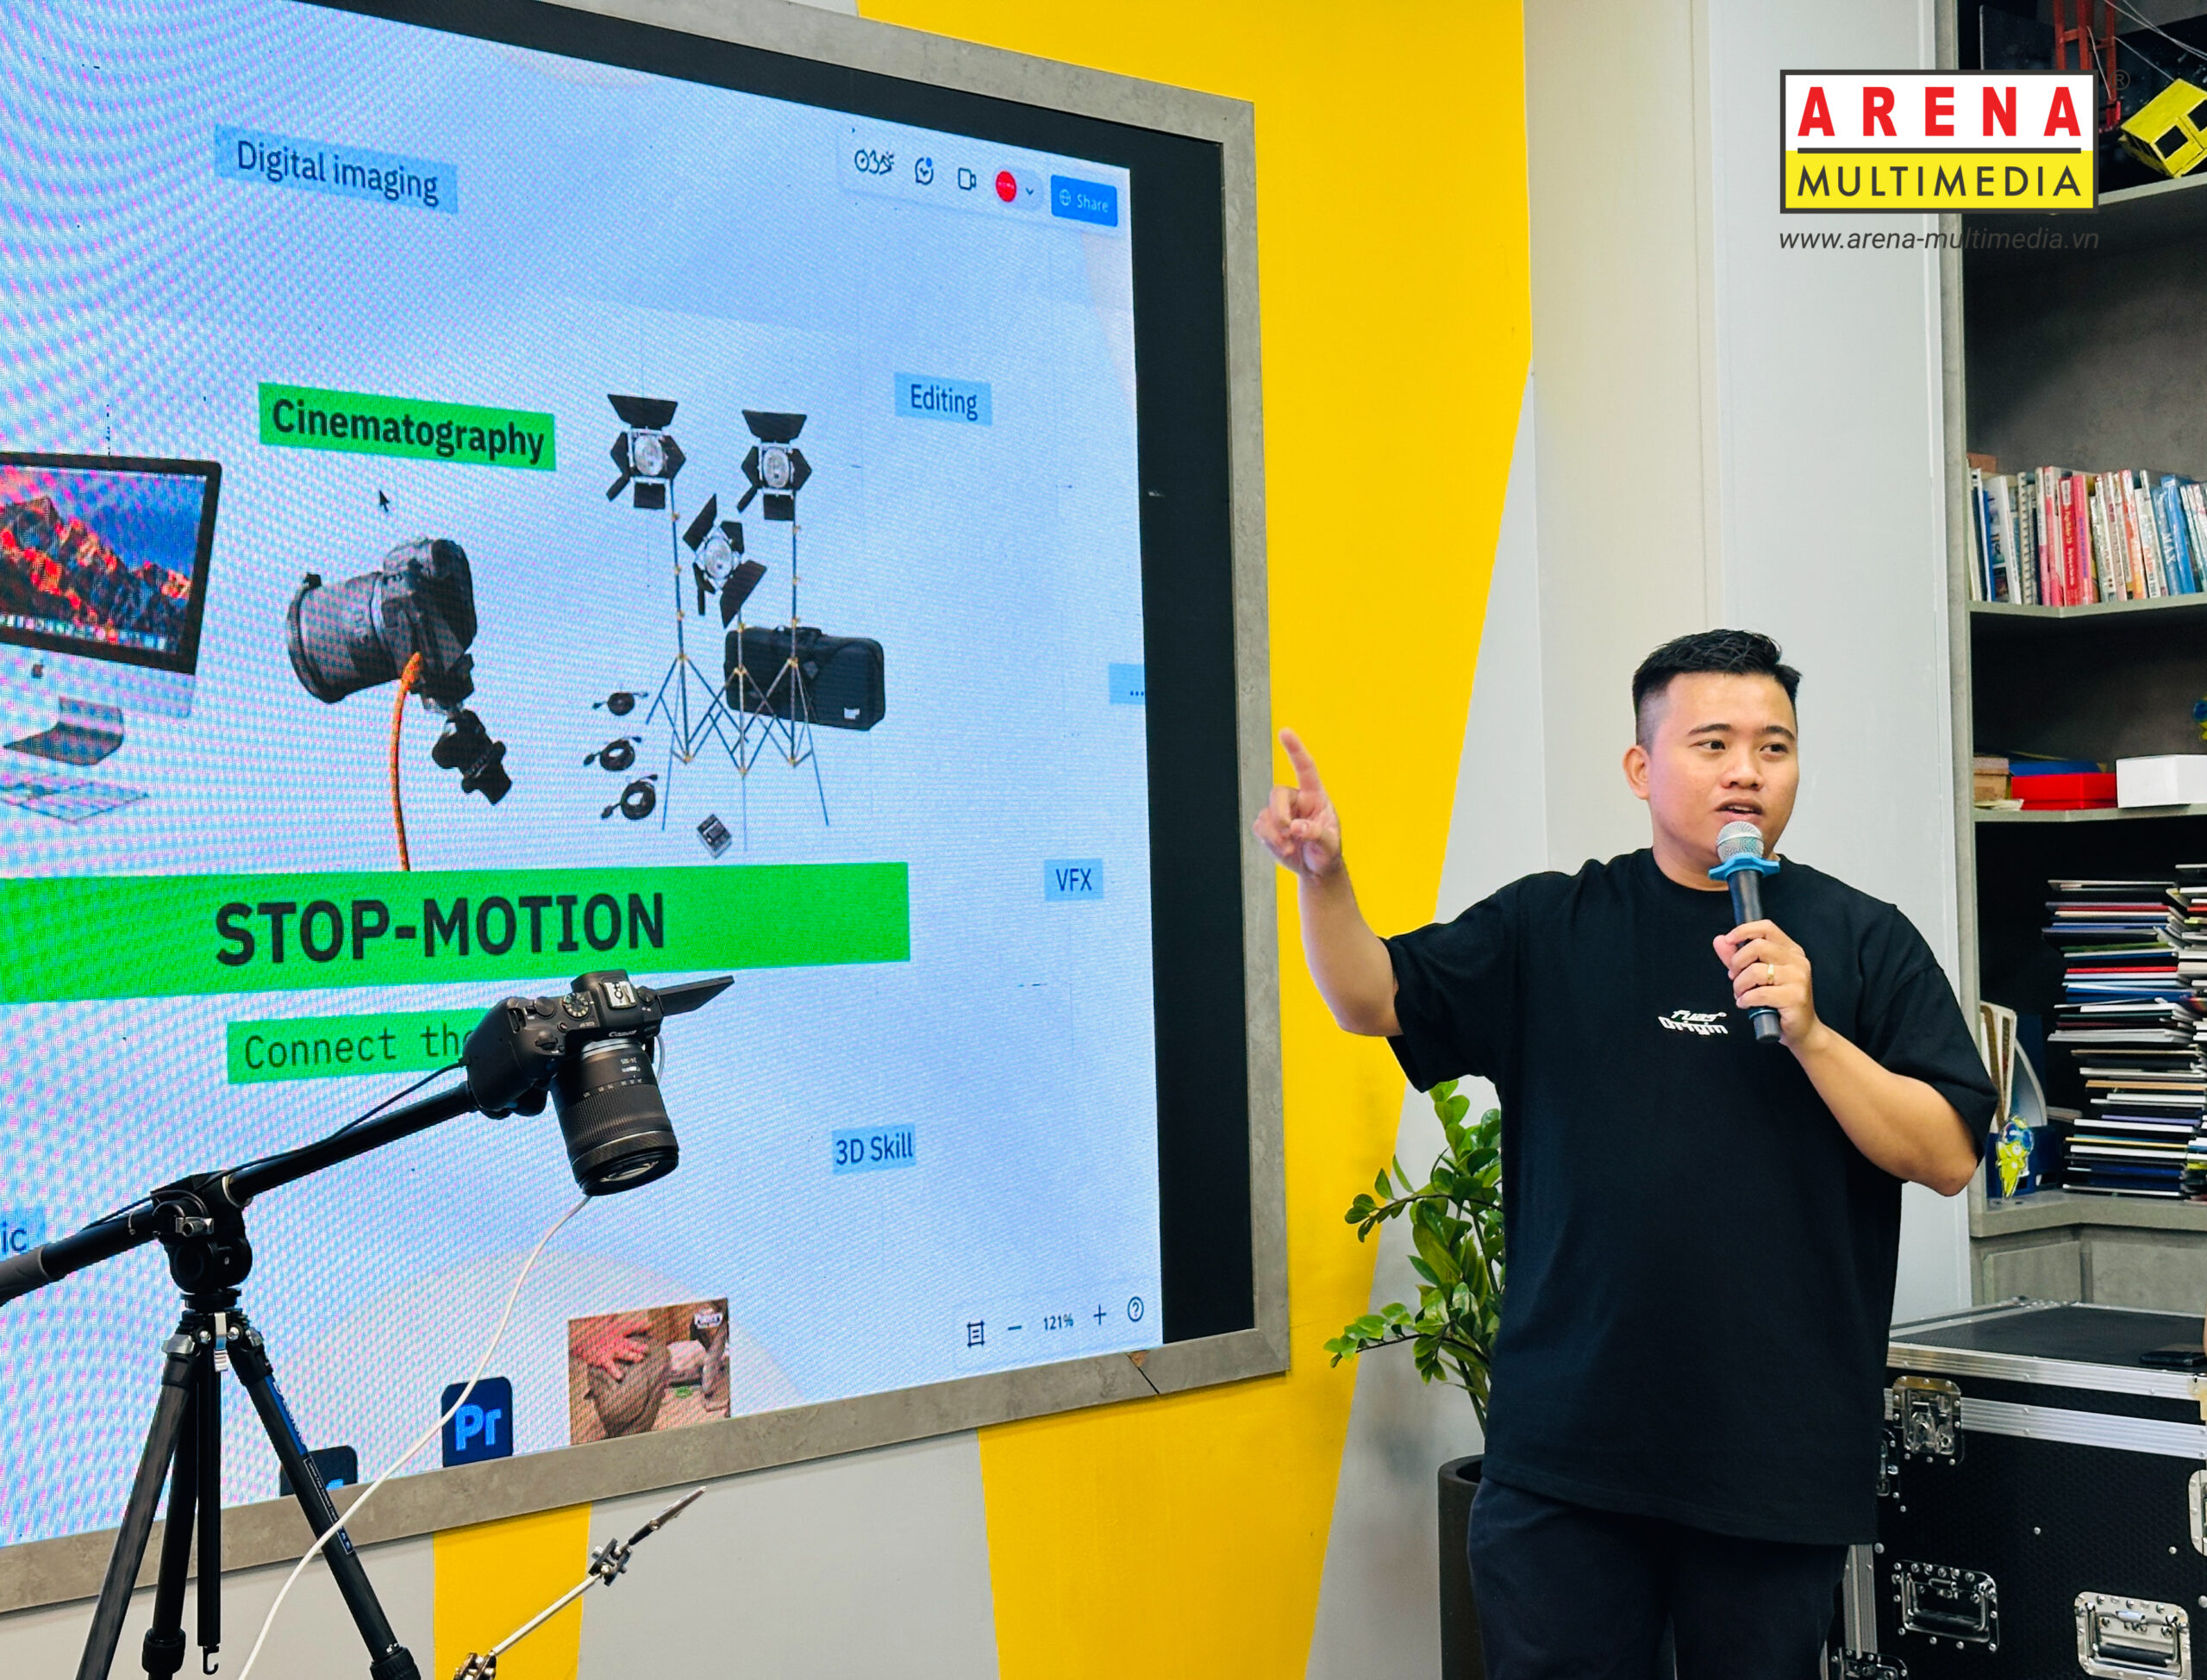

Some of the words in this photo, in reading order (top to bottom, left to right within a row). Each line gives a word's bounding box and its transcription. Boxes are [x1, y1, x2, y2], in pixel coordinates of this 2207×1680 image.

[237, 140, 327, 182] Digital
[333, 154, 439, 207] imaging
[1078, 194, 1109, 213] Share
[910, 383, 978, 422] Editing
[272, 398, 545, 465] Cinematography
[1056, 868, 1092, 892] VFX
[216, 892, 665, 965] STOP-MOTION
[245, 1027, 397, 1070] Connect
[835, 1137, 865, 1166] 3D
[870, 1130, 914, 1162] Skill
[1043, 1313, 1074, 1332] 121%
[454, 1402, 502, 1452] Pr
